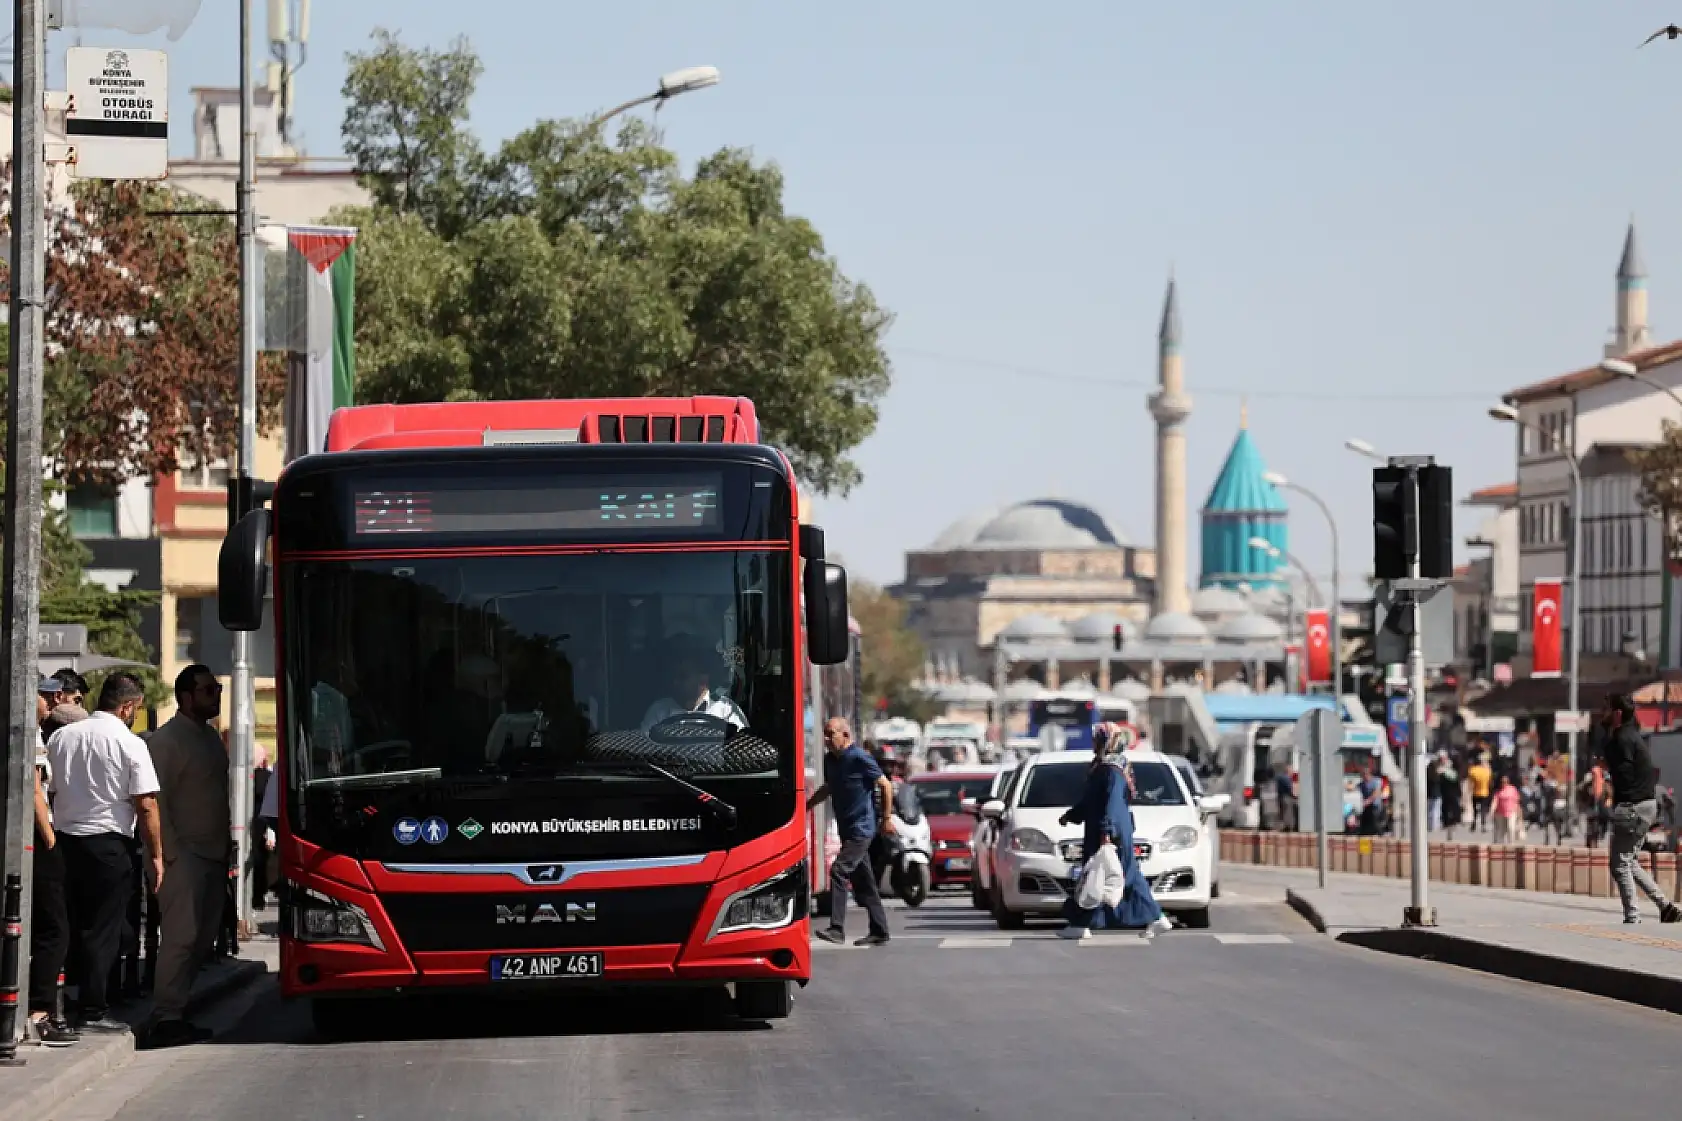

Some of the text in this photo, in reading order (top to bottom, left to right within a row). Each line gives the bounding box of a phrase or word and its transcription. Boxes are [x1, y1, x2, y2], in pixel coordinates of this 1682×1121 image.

[102, 69, 132, 77] KONYA
[102, 97, 153, 108] OTOBÜS
[104, 109, 152, 119] DURAĞI
[491, 821, 540, 835] KONYA
[542, 817, 620, 835] BÜYÜKŞEHİR
[496, 902, 596, 924] MAN
[501, 955, 598, 977] 42 ANP 461
